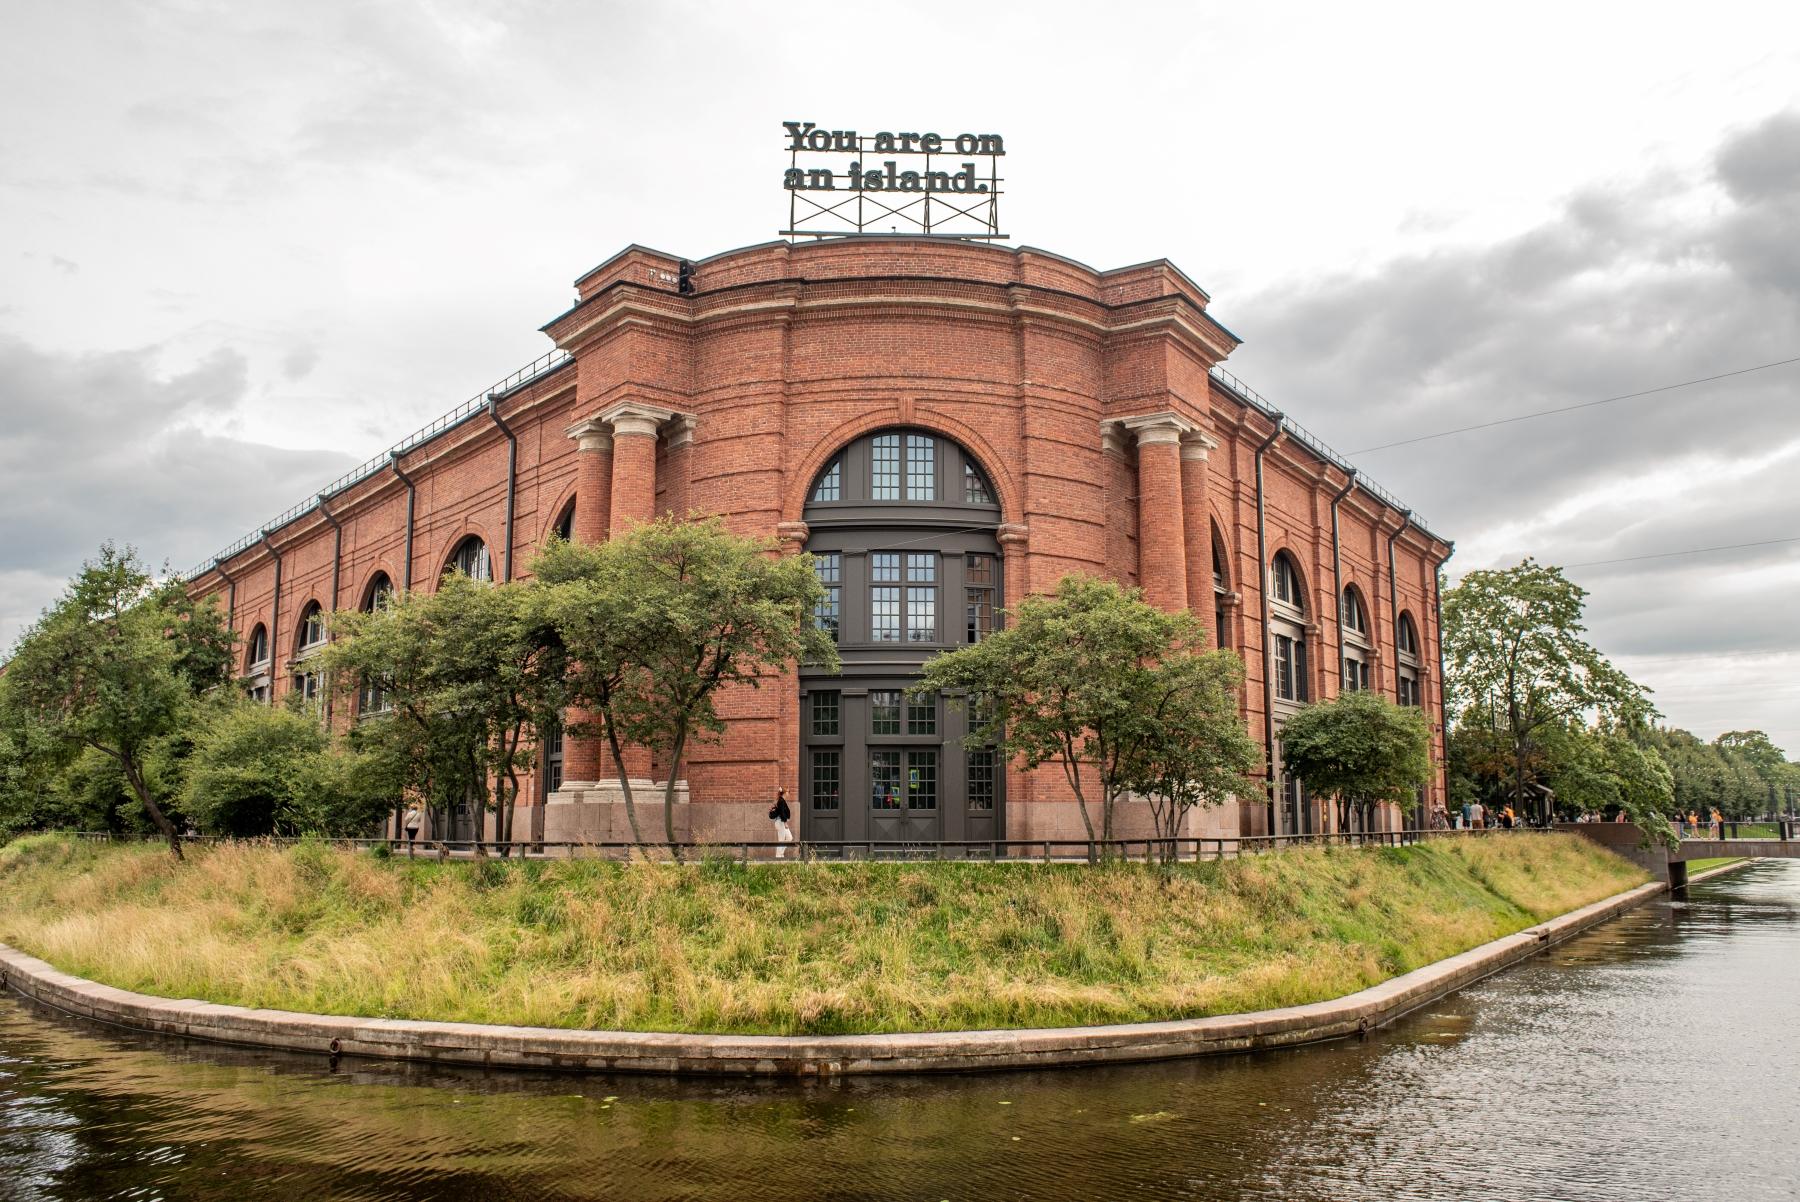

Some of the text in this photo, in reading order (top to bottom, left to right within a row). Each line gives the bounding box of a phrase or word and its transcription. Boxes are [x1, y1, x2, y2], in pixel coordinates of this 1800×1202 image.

[783, 122, 1006, 156] You are on
[784, 161, 988, 194] an island.
